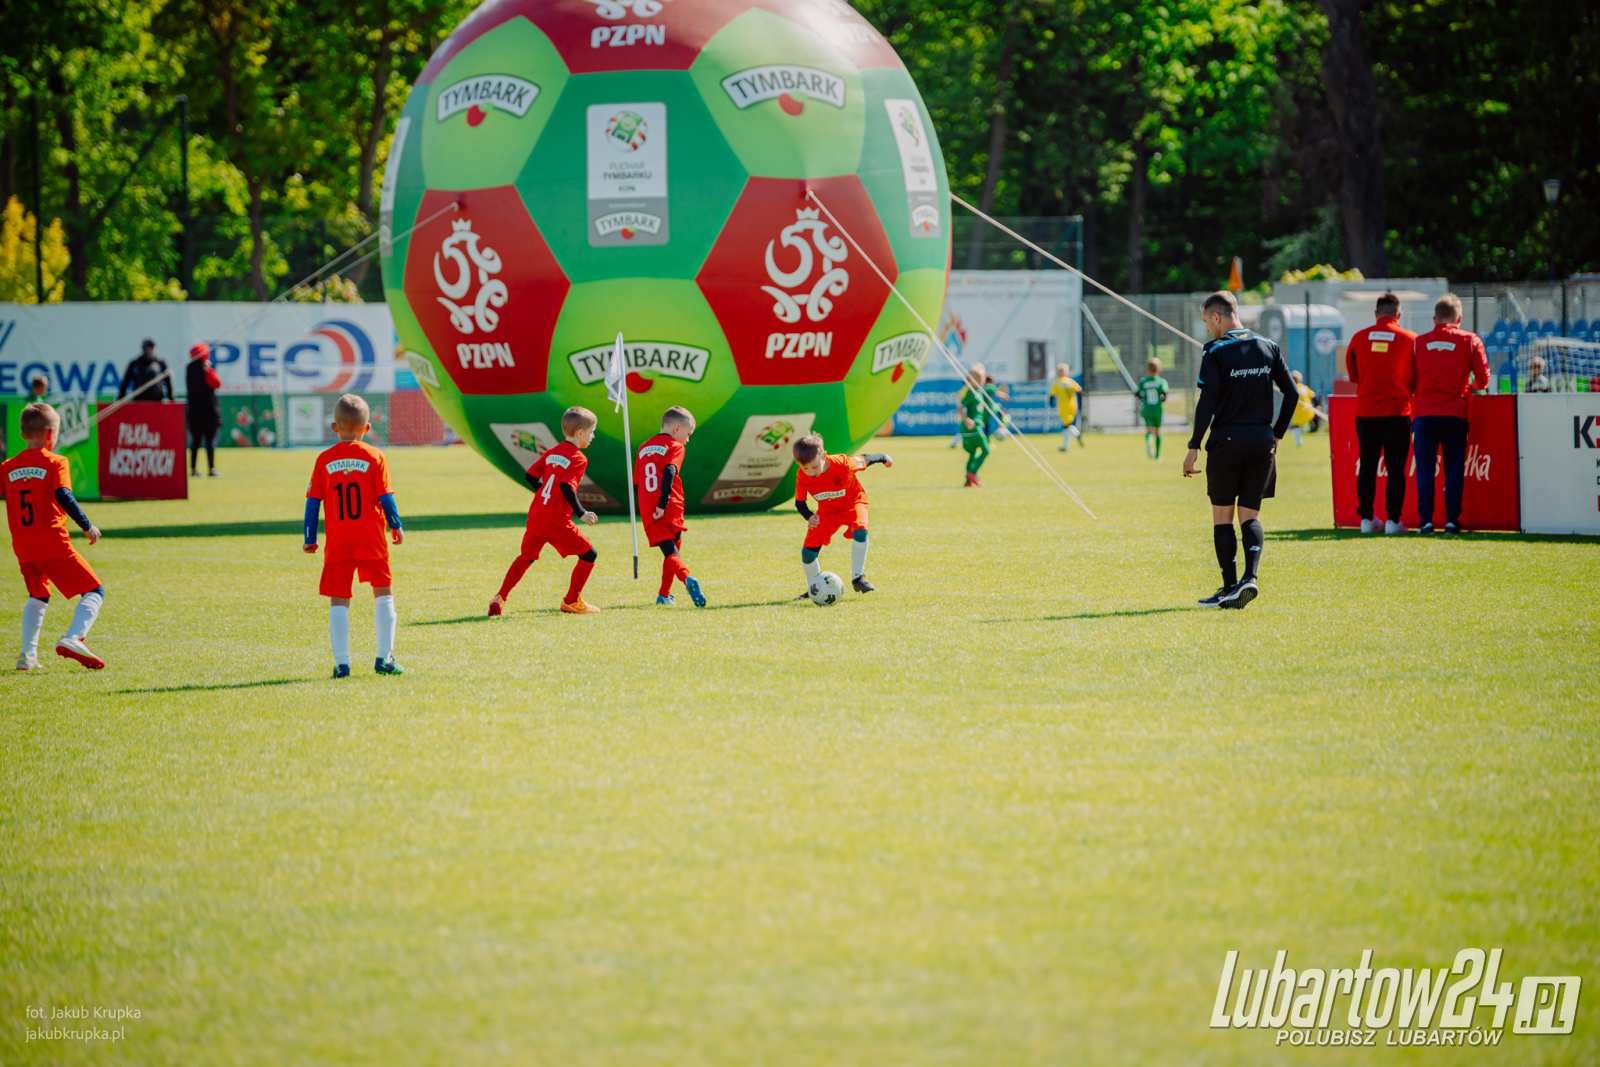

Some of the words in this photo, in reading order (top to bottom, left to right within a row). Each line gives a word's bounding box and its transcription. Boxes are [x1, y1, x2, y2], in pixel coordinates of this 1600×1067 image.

[591, 24, 665, 48] PZPN
[443, 80, 530, 111] TYMBARK
[731, 69, 838, 99] TYMBARK
[600, 215, 656, 231] TYMBARK
[456, 342, 516, 369] PZPN
[765, 331, 833, 359] PZPN
[208, 343, 321, 377] PEC
[11, 468, 45, 479] TYMBARK
[328, 460, 366, 472] TYMBARK
[644, 463, 658, 492] 8
[333, 482, 361, 520] 10
[541, 474, 556, 506] 4
[19, 489, 34, 527] 5
